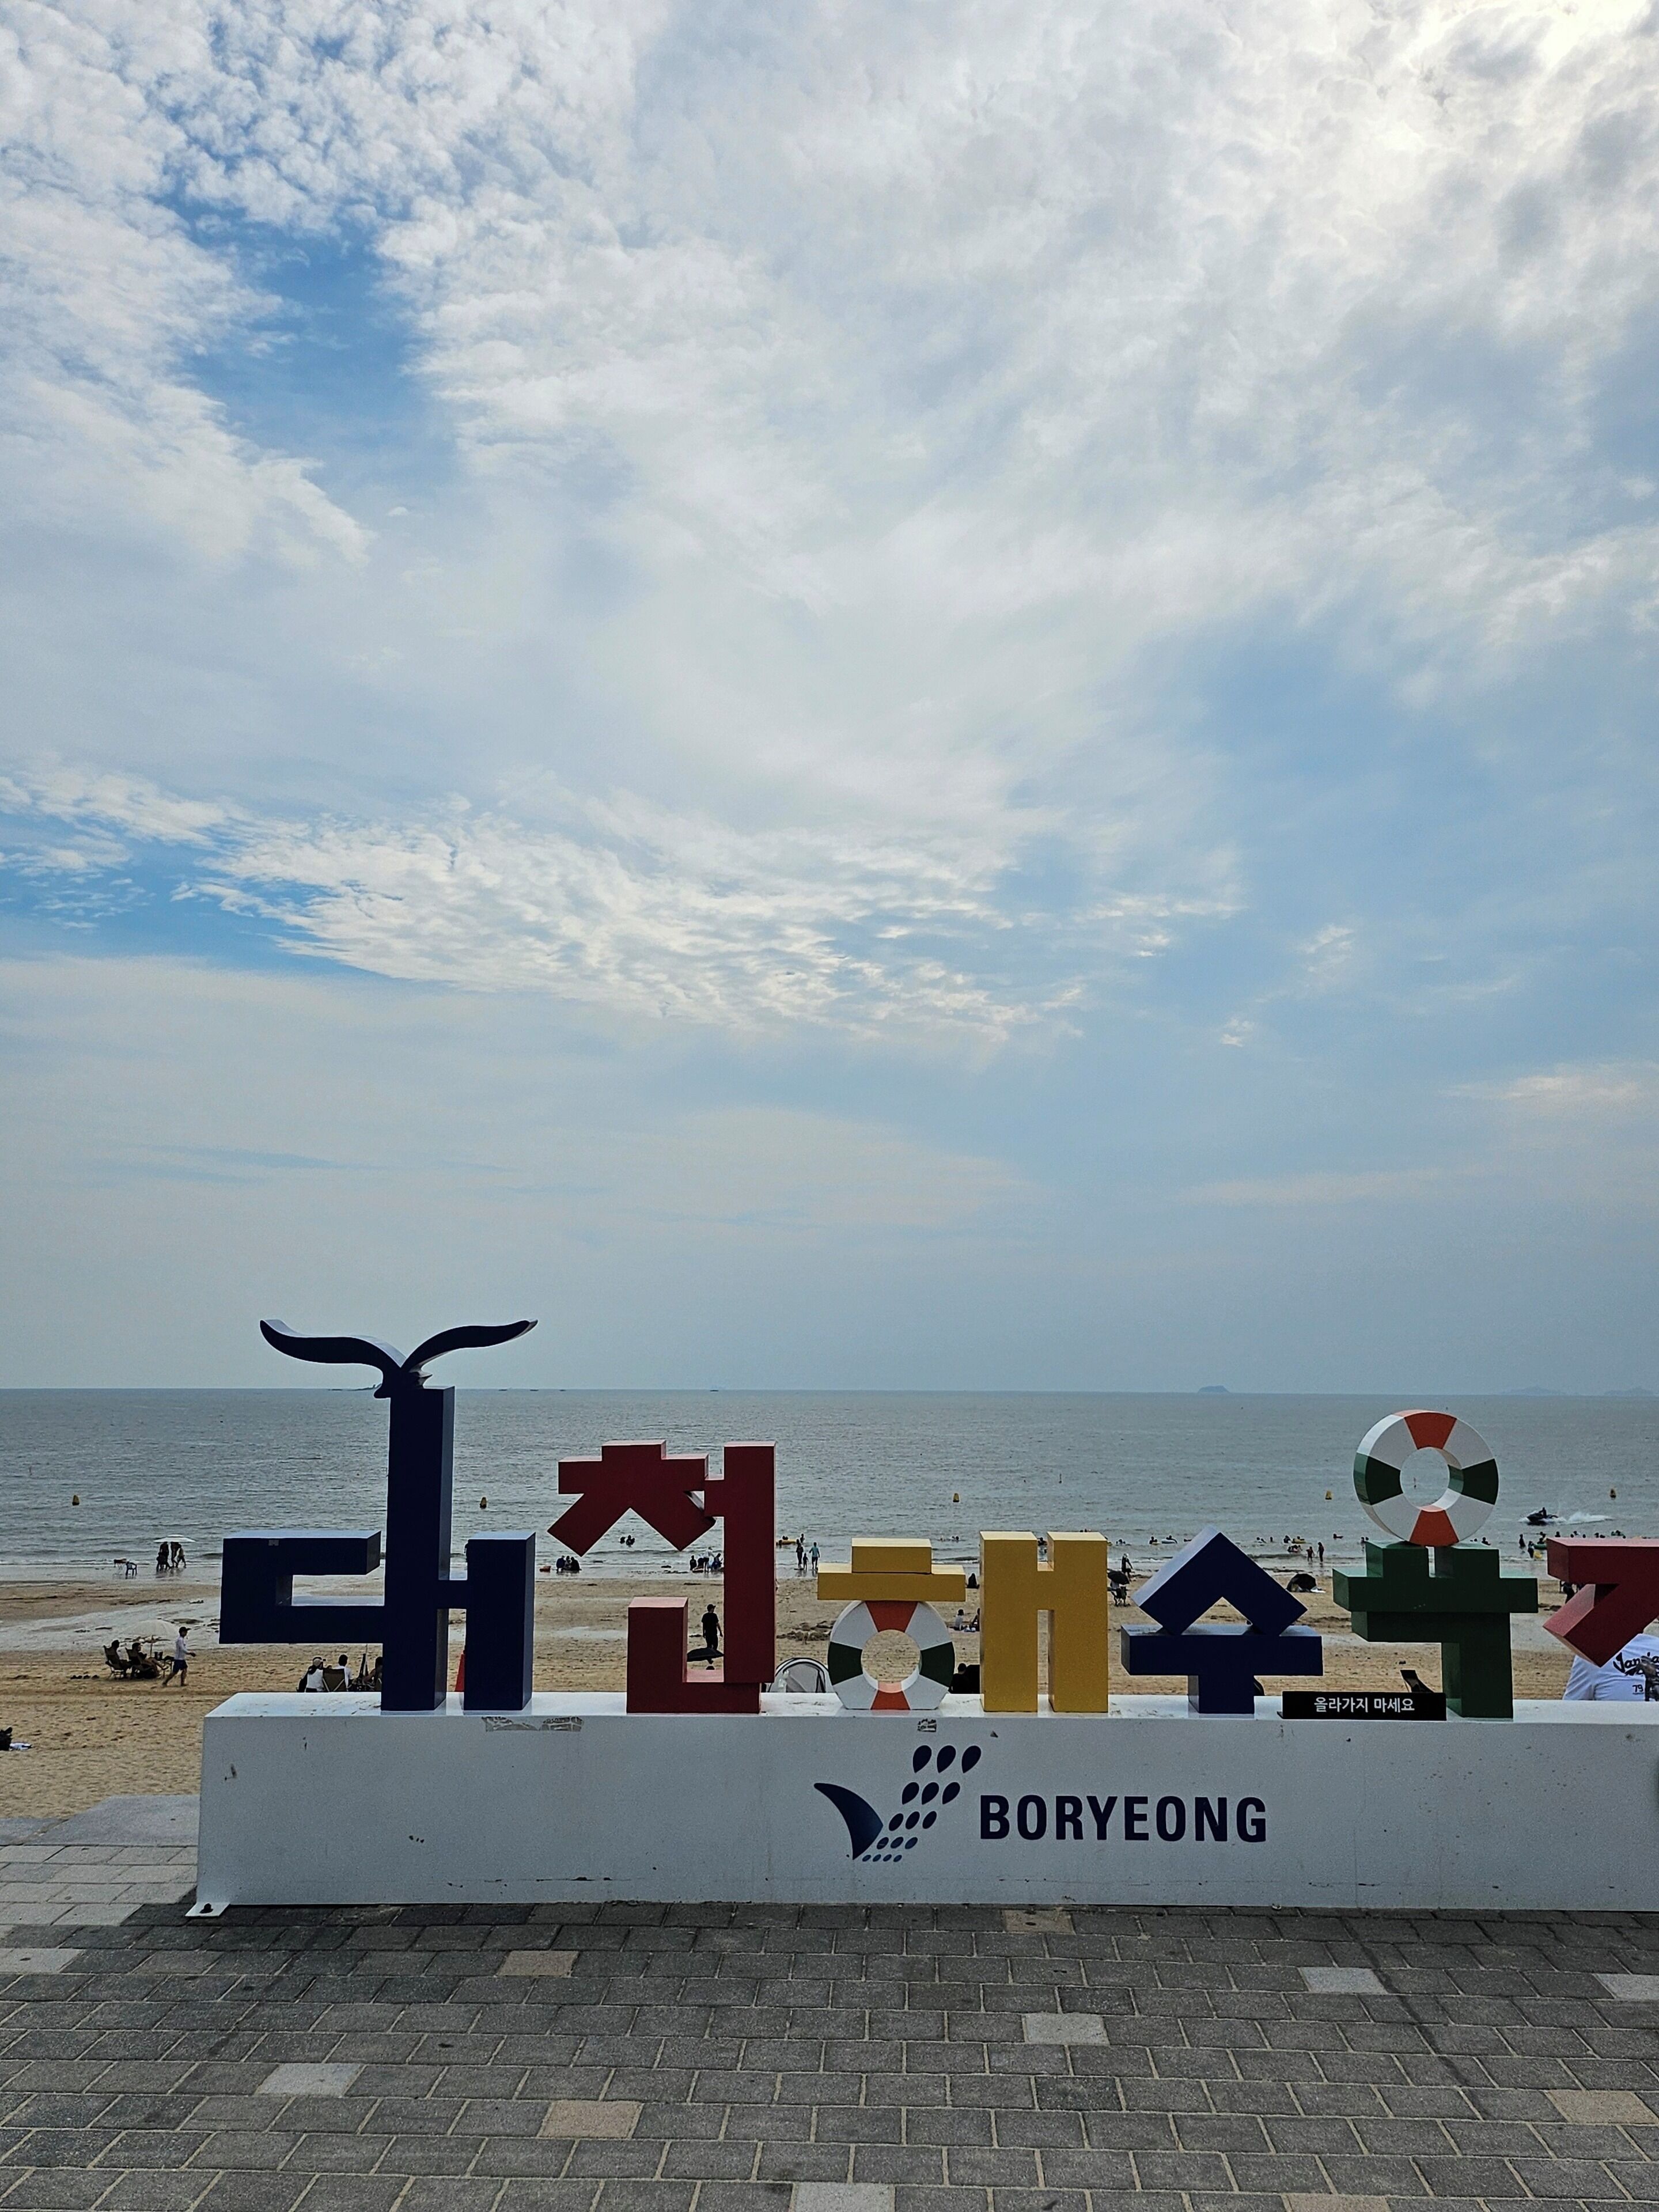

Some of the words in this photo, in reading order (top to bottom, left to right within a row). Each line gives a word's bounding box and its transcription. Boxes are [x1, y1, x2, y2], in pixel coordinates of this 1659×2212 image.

[1314, 1697, 1368, 1713] 올라가지
[1374, 1697, 1415, 1713] 마세요
[980, 1794, 1266, 1842] BORYEONG
